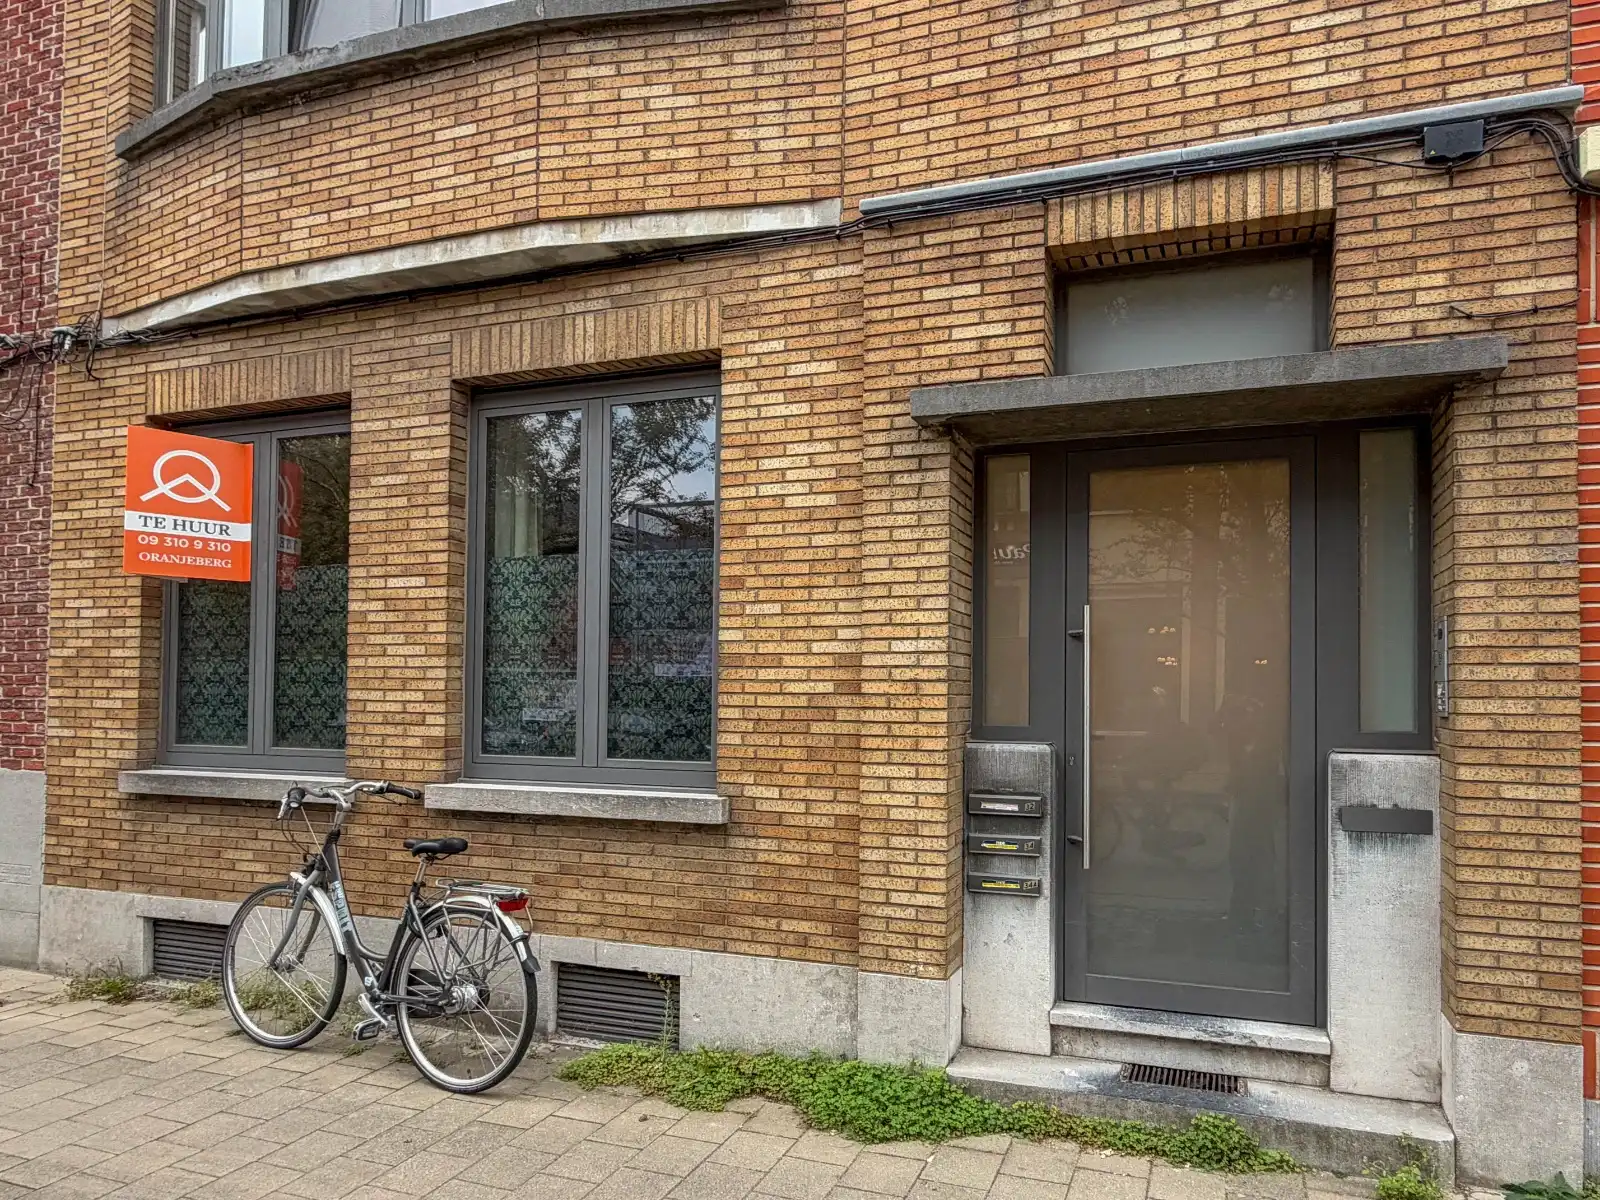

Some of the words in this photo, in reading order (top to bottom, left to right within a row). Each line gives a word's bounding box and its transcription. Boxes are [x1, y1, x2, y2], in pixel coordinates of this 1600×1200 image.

[138, 514, 166, 529] TE
[172, 518, 231, 537] HUUR
[138, 534, 158, 546] 09
[163, 536, 189, 548] 310
[193, 538, 203, 550] 9
[207, 540, 231, 552] 310
[138, 551, 232, 568] ORANJEBERG
